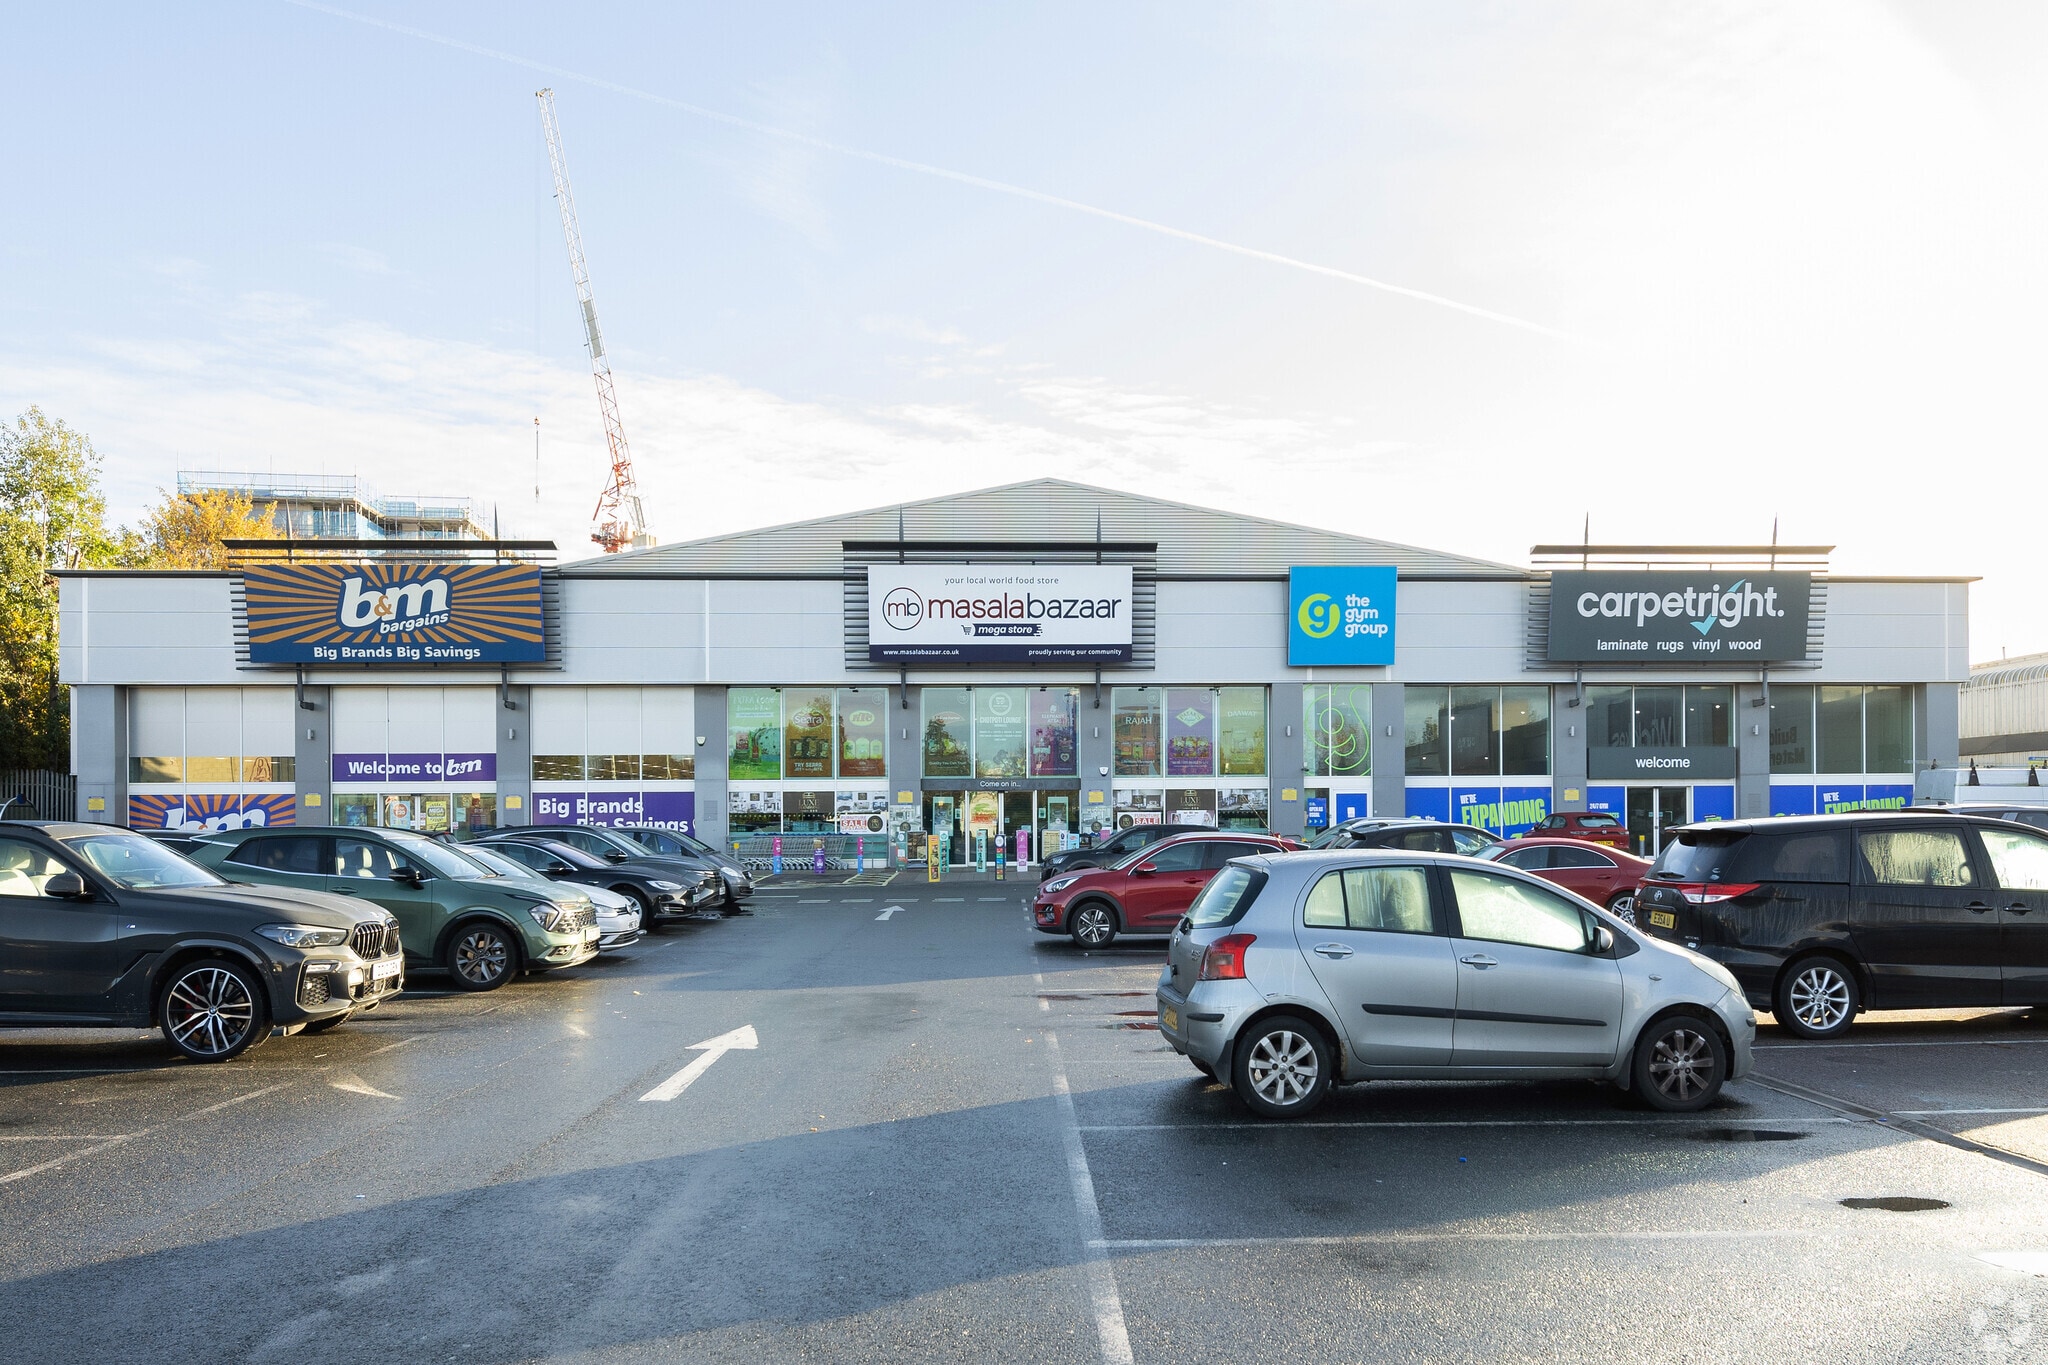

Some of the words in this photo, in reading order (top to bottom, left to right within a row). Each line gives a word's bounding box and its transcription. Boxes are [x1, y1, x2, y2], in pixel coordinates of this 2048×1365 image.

[944, 577, 964, 585] your
[966, 576, 987, 584] local
[989, 576, 1013, 584] world
[1015, 576, 1035, 584] food
[1037, 577, 1060, 585] store
[341, 577, 450, 628] b&m
[887, 597, 920, 617] mb
[928, 592, 1122, 619] masalabazaar
[1344, 593, 1371, 607] the
[1577, 582, 1785, 628] carpetright.
[1344, 607, 1379, 623] gym
[379, 612, 449, 634] bargains
[977, 625, 1006, 636] mega
[1007, 625, 1033, 635] store
[1344, 623, 1389, 638] group
[313, 646, 337, 660] Big
[341, 646, 392, 658] Brands
[396, 646, 421, 660] Big
[424, 646, 481, 660] Savings
[1596, 639, 1649, 651] laminate
[1656, 641, 1685, 653] rugs
[1692, 639, 1721, 653] vinyl
[1728, 639, 1762, 651] wood
[794, 714, 823, 724] Seara
[1125, 716, 1153, 726] RAJAH
[348, 760, 421, 775] Welcome
[425, 761, 442, 775] to
[446, 758, 482, 776] b&m
[1635, 756, 1691, 768] welcome
[1459, 793, 1478, 804] WE'RE
[538, 798, 570, 818] Big
[576, 797, 644, 814] Brands
[1461, 798, 1546, 829] EXPANDING
[613, 817, 689, 832] Savings
[841, 819, 867, 827] SALE
